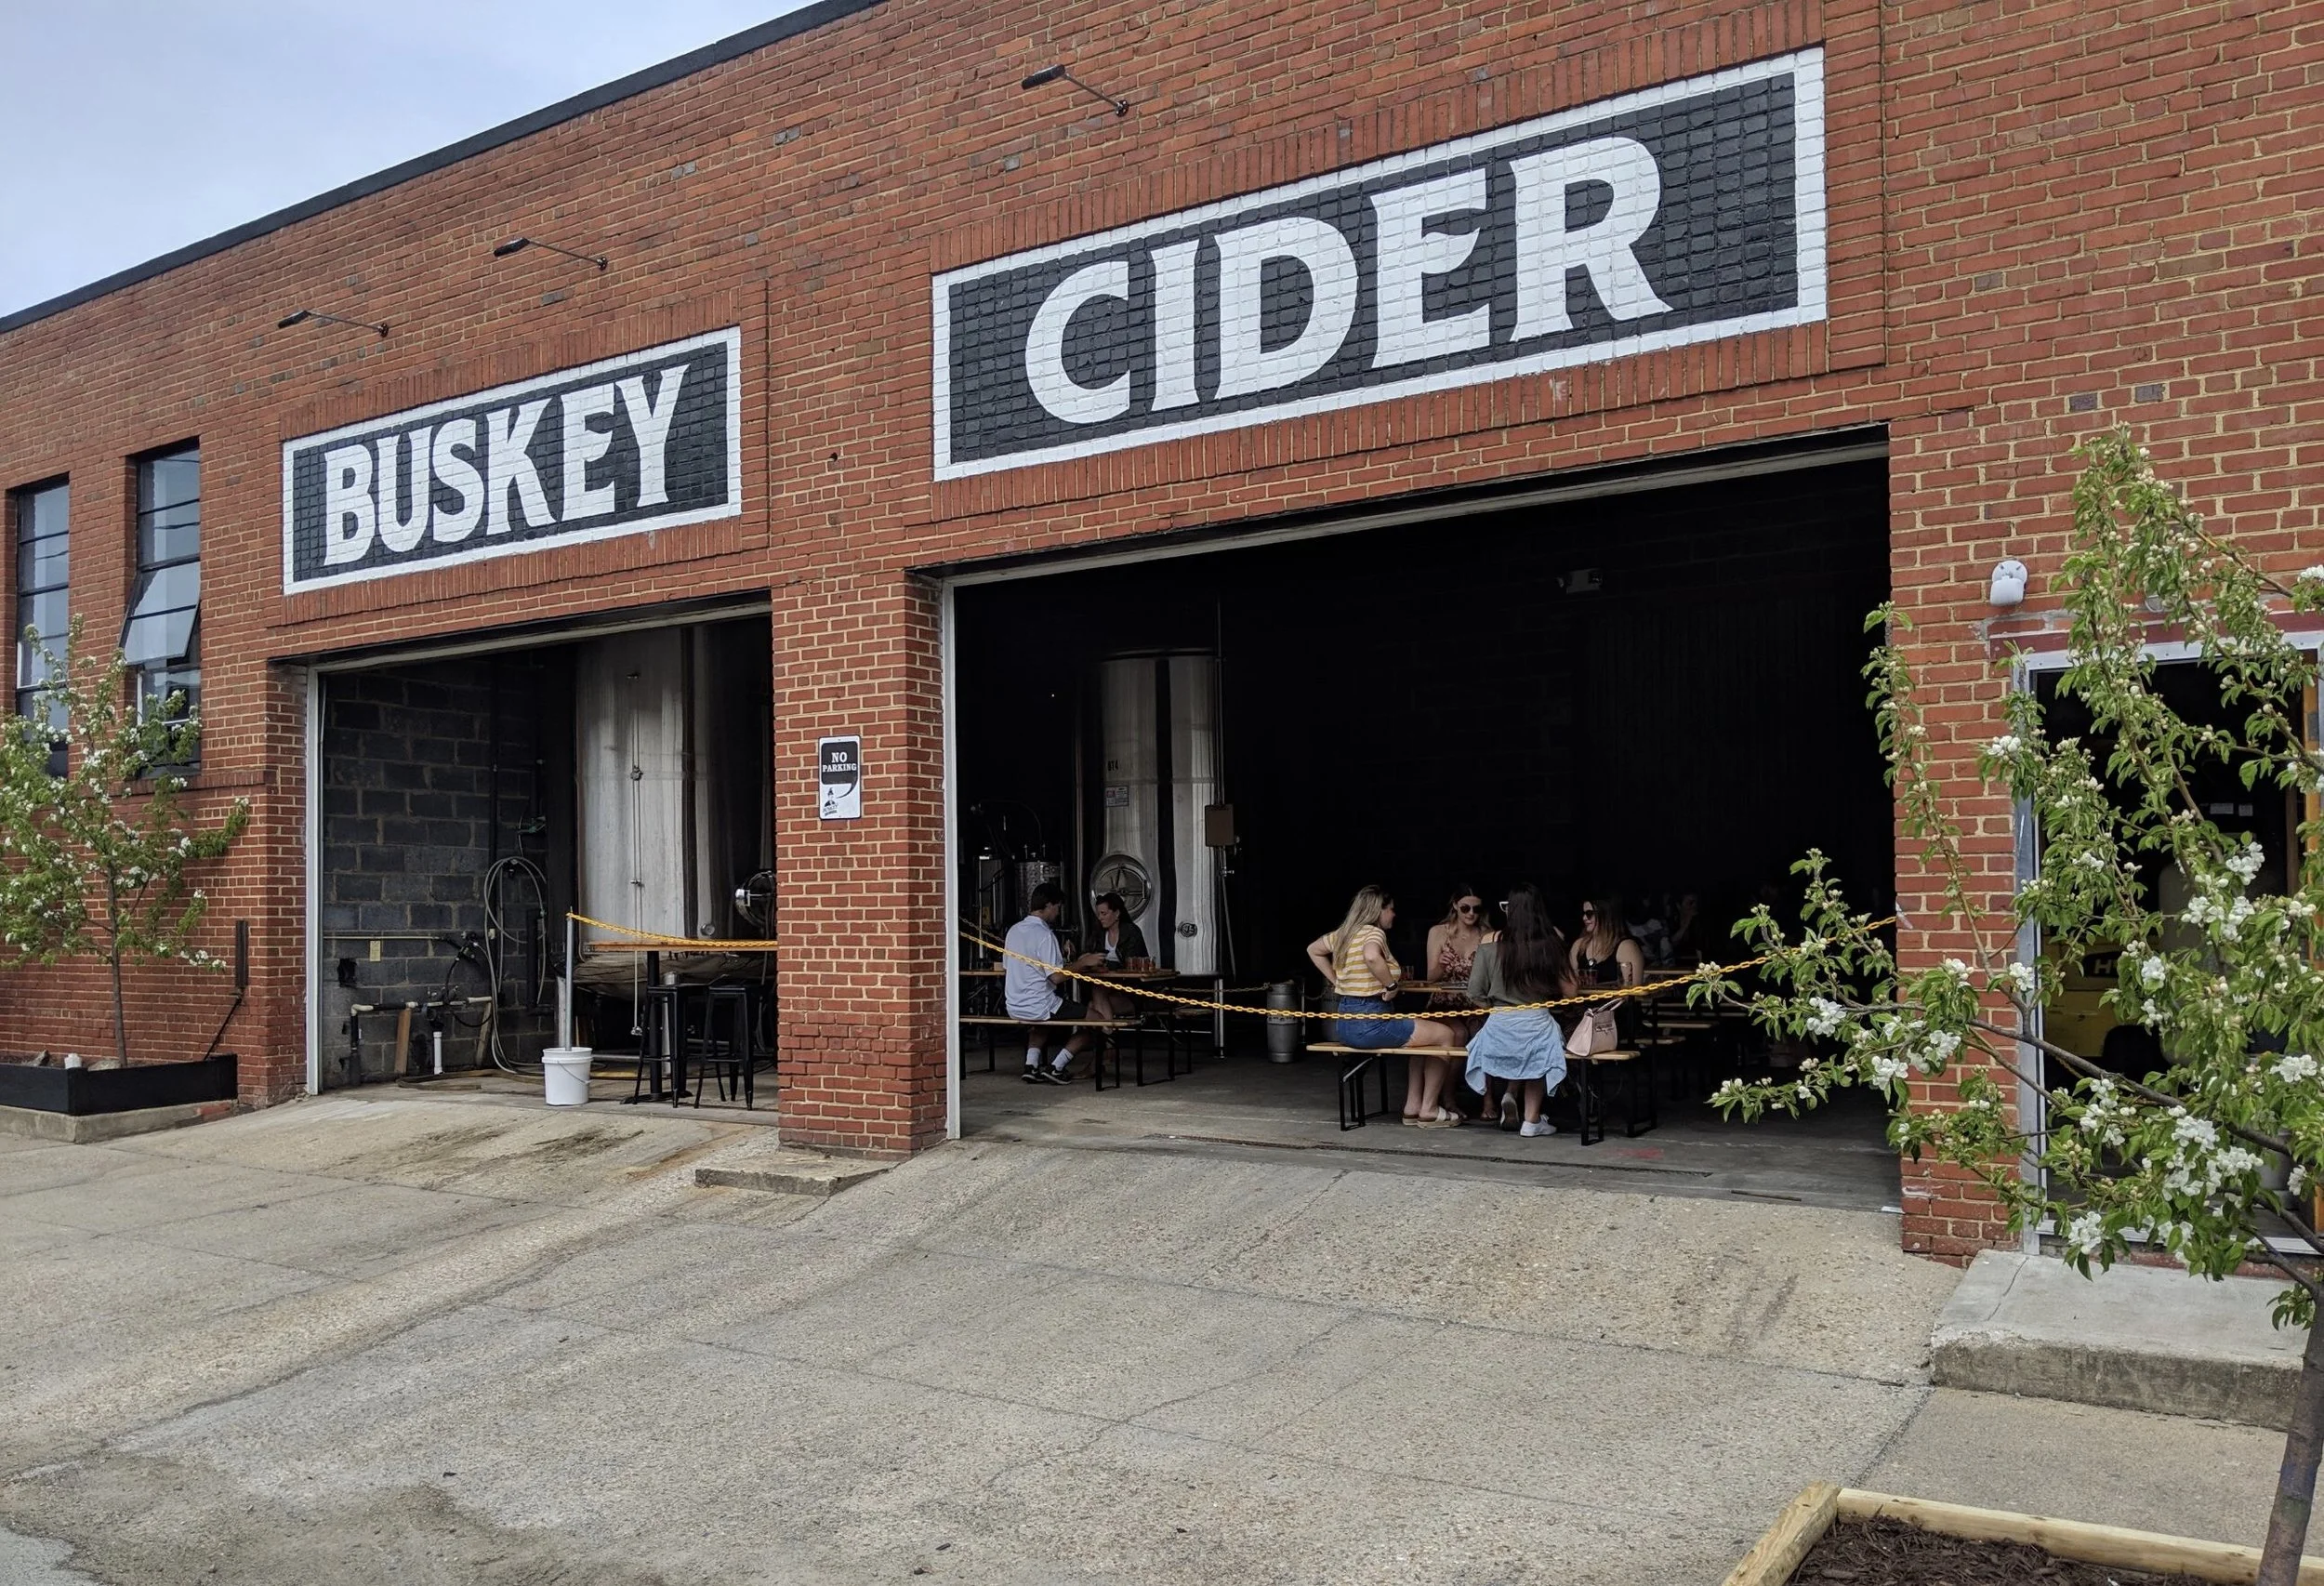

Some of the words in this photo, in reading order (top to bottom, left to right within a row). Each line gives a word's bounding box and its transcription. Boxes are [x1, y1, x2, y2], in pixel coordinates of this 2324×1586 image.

[1024, 137, 1674, 425] CIDER
[324, 363, 690, 566] BUSKEY
[822, 763, 857, 773] PARKING
[831, 751, 848, 763] NO
